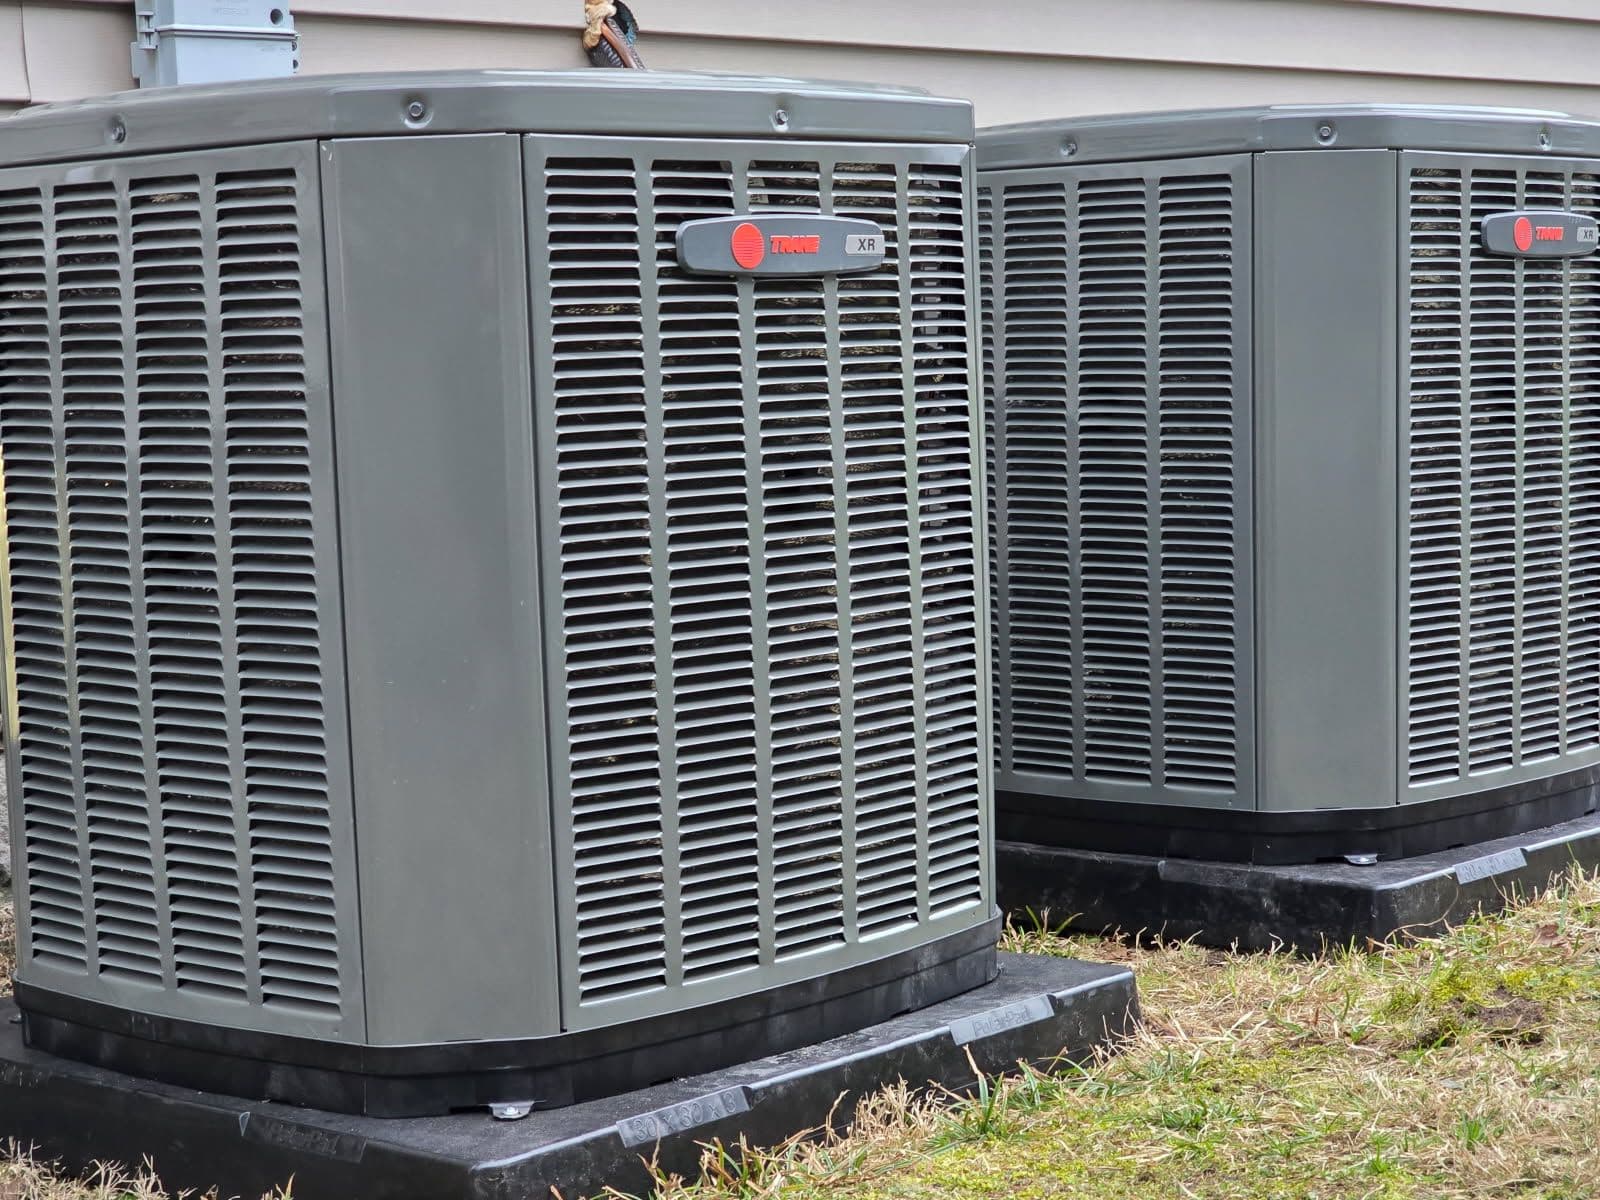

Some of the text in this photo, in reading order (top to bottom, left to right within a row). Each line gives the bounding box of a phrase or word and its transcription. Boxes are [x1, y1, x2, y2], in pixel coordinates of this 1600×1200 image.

[770, 234, 876, 254] TRANE XR
[1583, 229, 1594, 240] XR
[632, 1116, 658, 1142] 30
[679, 1102, 704, 1127] 30
[723, 1091, 737, 1113] 3
